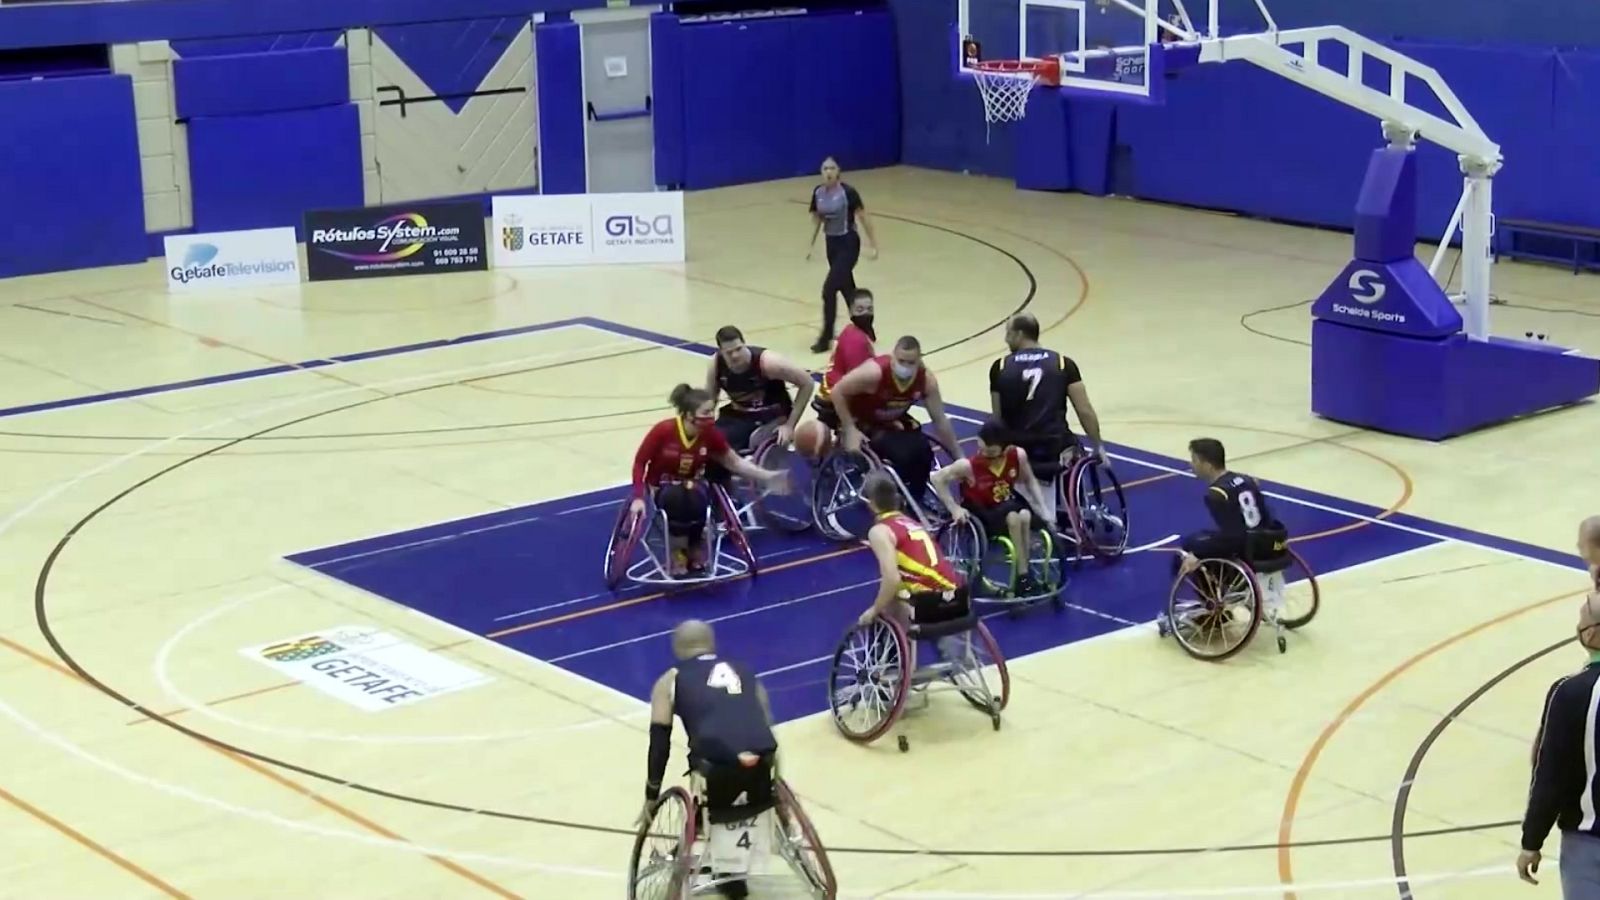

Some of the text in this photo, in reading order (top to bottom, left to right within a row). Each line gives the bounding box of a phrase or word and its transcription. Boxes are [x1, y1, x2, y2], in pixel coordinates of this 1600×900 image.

[529, 232, 584, 246] GETAFE
[1371, 310, 1406, 323] Sports
[1022, 367, 1044, 401] 7
[1238, 490, 1261, 529] 8
[907, 529, 938, 567] 7
[311, 658, 425, 704] GETAFE
[707, 661, 742, 694] 4
[736, 830, 753, 851] 4
